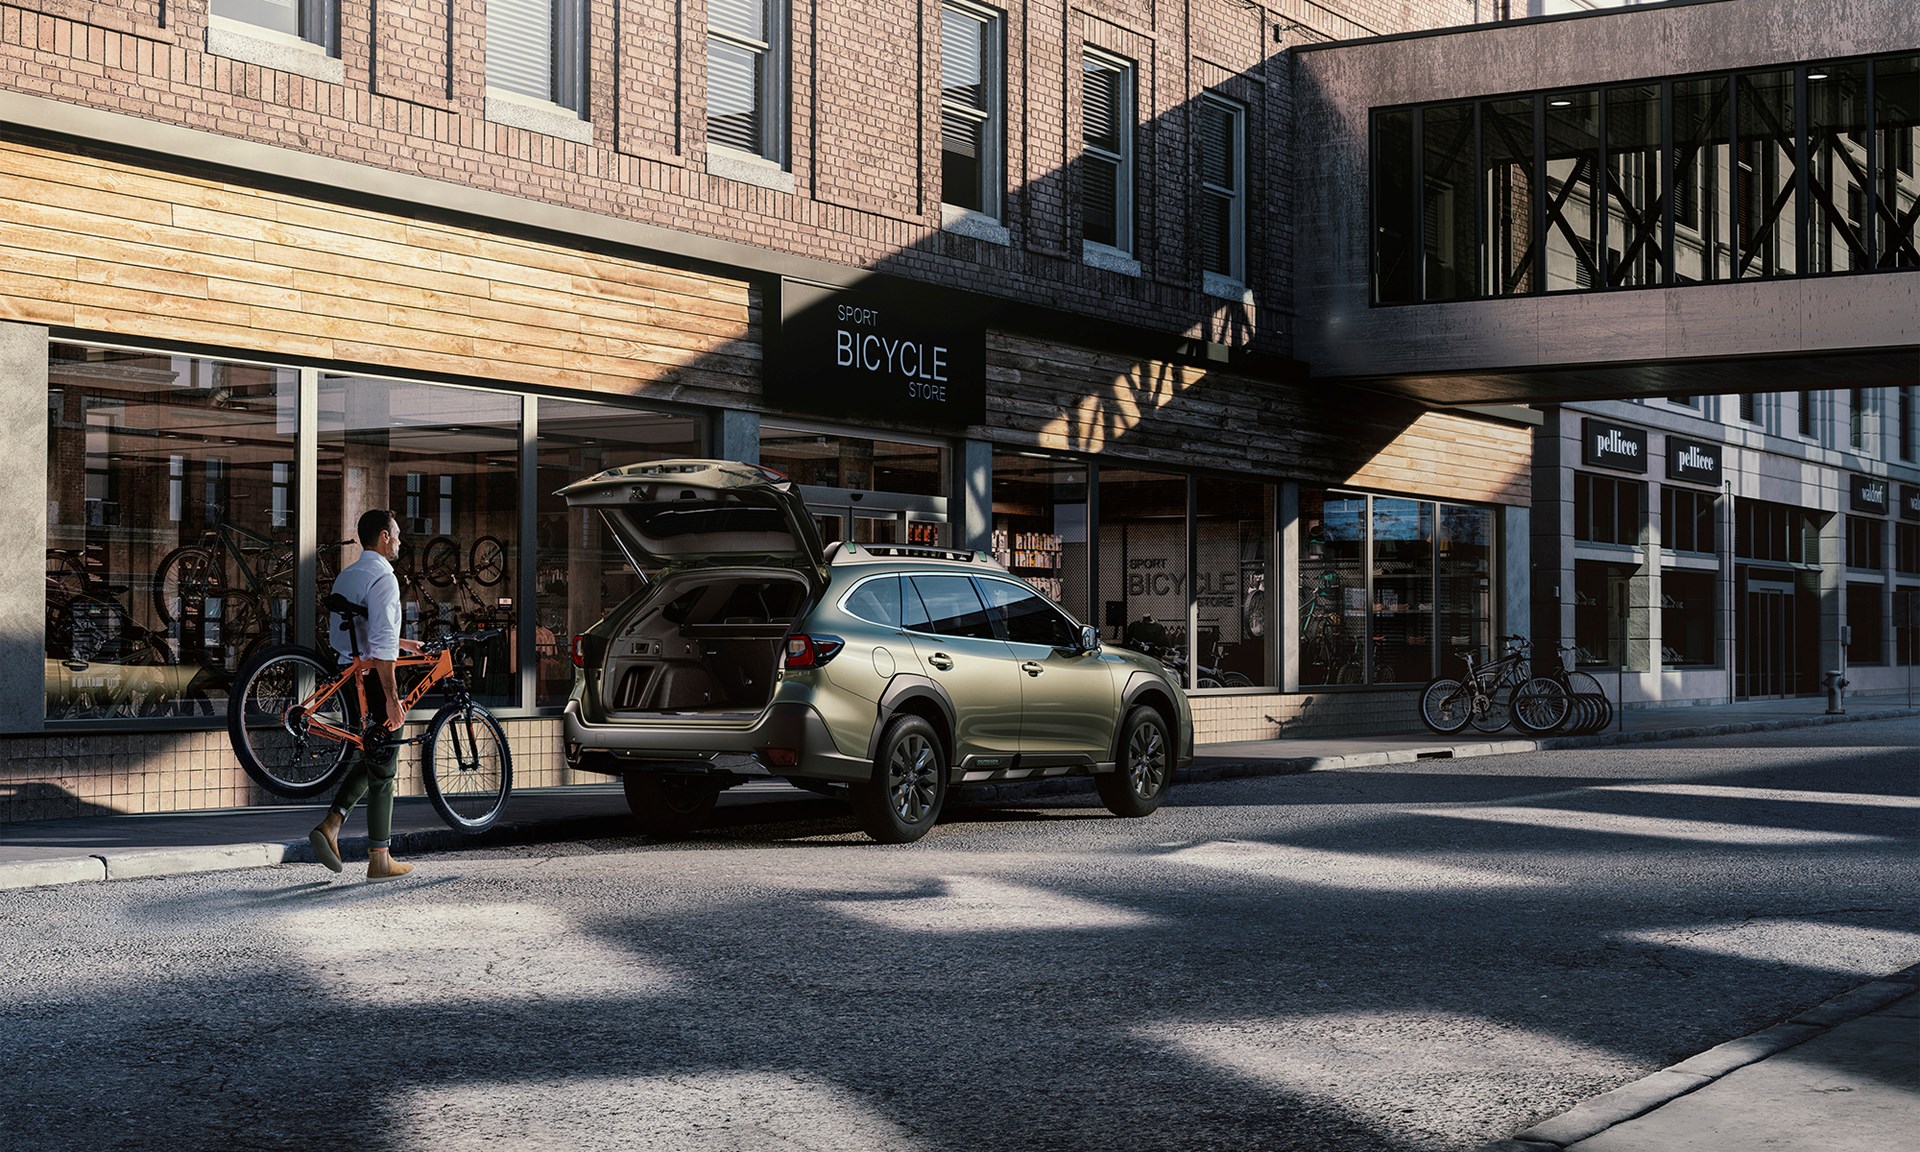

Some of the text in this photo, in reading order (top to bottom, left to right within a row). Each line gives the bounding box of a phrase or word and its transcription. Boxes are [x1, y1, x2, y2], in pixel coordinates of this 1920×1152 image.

[837, 304, 878, 326] SPORT
[837, 329, 948, 382] BICYCLE
[908, 381, 946, 402] STORE
[1597, 429, 1638, 457] pellicce
[1678, 446, 1714, 472] pellicce
[1129, 558, 1167, 570] SPORT
